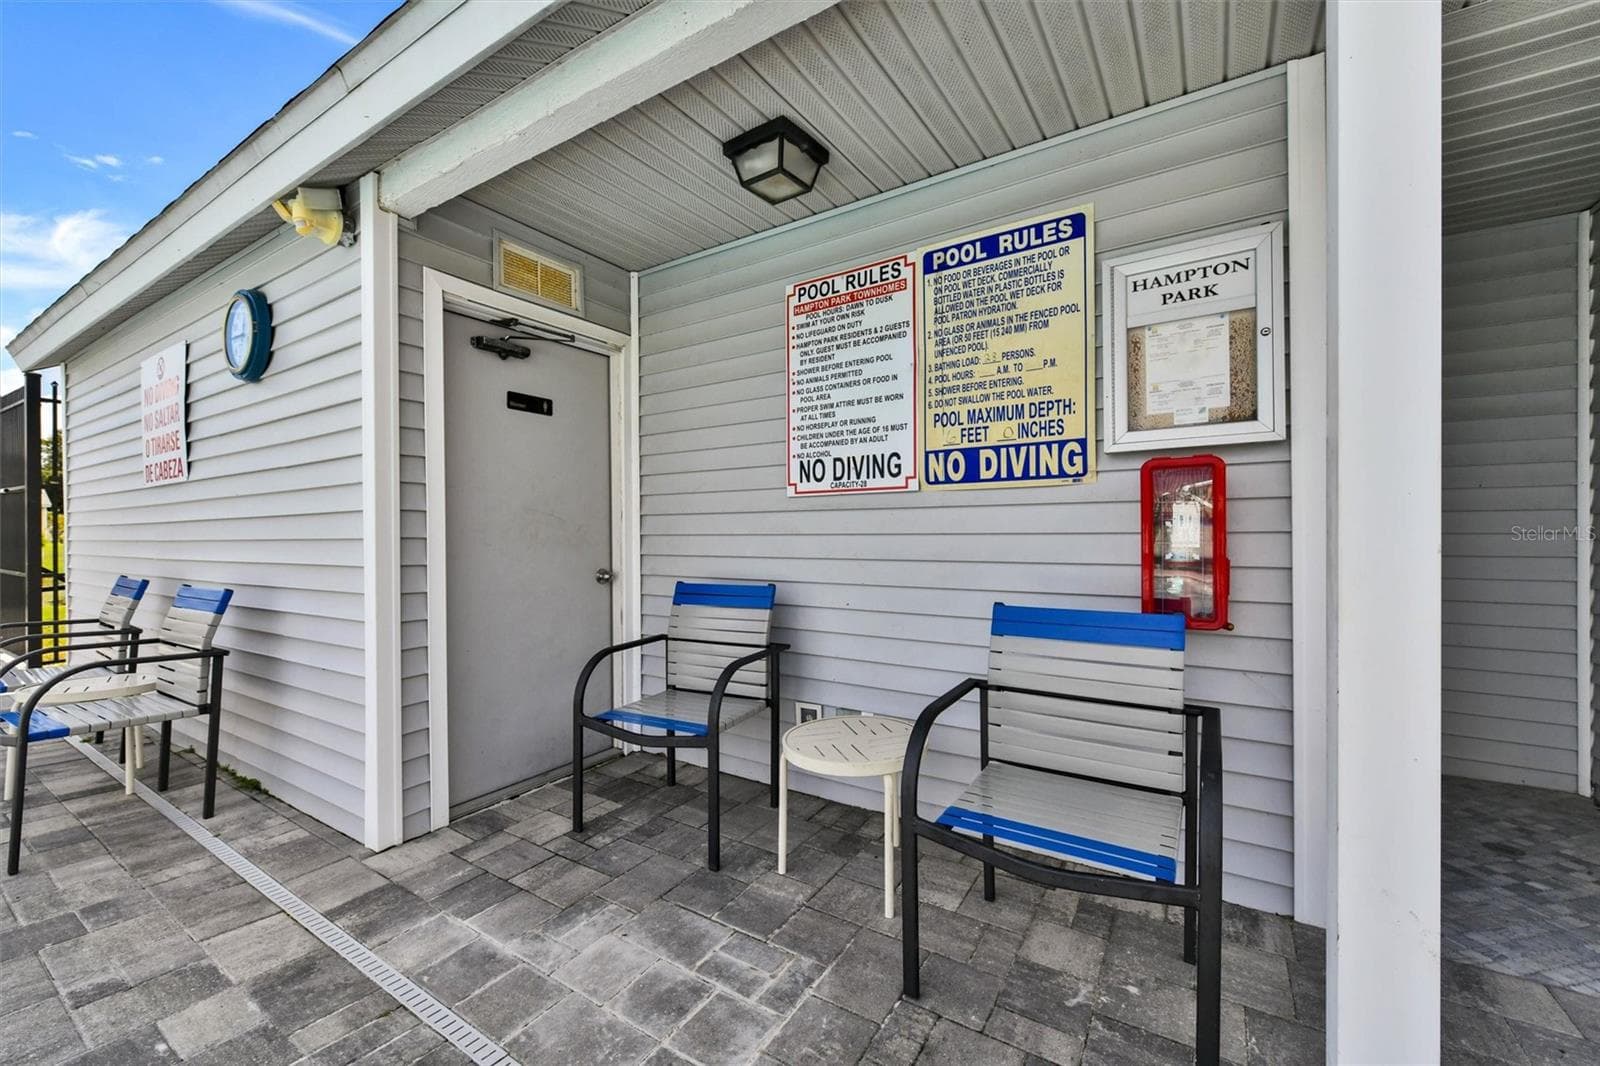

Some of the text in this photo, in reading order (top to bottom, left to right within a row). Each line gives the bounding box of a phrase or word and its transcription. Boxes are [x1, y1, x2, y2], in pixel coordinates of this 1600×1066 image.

[933, 219, 1073, 270] POOL RULES
[933, 246, 1070, 286] NO FOOD OR BEVERAGES IN THE POOL OR
[1132, 258, 1251, 292] HAMPTON
[798, 262, 901, 302] POOL RULES
[934, 260, 1053, 295] ON POOL WET COMMERCIALLY
[934, 270, 1064, 306] BOTTLED WATER IN PLASTIC BOTTLES IS
[794, 280, 906, 315] HAMPTON PARK TOWNHOMES
[934, 281, 1062, 315] ALLOWED ON THE POOL WET DECK FOR
[1162, 284, 1218, 305] PARK
[806, 310, 821, 320] POOL
[846, 301, 864, 311] DAWN
[866, 299, 874, 307] TO
[876, 295, 893, 305] DUSK
[934, 309, 977, 325] POOL PATRON
[796, 309, 865, 331] SWIM AT YOUR OWN RISK
[796, 320, 863, 340] NO LIFEGUARD ON DUTY
[934, 303, 1080, 338] NO GLASS OR ANIMALS IN THE FENCED POOL
[796, 320, 910, 350] HAMPTON PARK RESIDENTS GUESTS
[816, 331, 907, 355] GUEST MUST BE ACCOMPANIED
[935, 337, 950, 347] AREA
[973, 330, 989, 341] FEET
[1029, 319, 1049, 332] FROM
[809, 354, 835, 365] RESIDENT
[934, 345, 966, 359] UNFENCED
[797, 354, 893, 376] SHOWER BEFORE ENTERING POOL
[935, 359, 960, 372] BATHING
[935, 373, 950, 384] POOL
[1013, 363, 1023, 374] TO
[806, 374, 829, 384] ANIMALS
[831, 369, 863, 380] PERMITTED
[806, 385, 824, 393] GLASS
[825, 380, 861, 391] CONTAINERS
[873, 375, 890, 384] FOOD
[800, 393, 831, 403] POOL AREA
[935, 385, 961, 397] SHOWER
[962, 381, 987, 393] BEFORE
[935, 399, 943, 409] DO
[944, 397, 957, 408] NOT
[958, 393, 991, 406] SWALLOW
[992, 392, 1005, 402] THE
[1006, 389, 1025, 400] POOL
[797, 404, 818, 413] PROPER
[820, 402, 834, 410] SWIM
[835, 400, 855, 408] ATTIRE
[857, 397, 873, 405] MUST
[884, 393, 904, 402] WORN
[934, 398, 1076, 428] POOL MAXIMUM DEPTH:
[806, 421, 838, 430] HORSEPLAY
[849, 416, 876, 425] RUNNING
[819, 411, 836, 419] TIMES
[797, 432, 824, 441] CHILDREN
[825, 430, 844, 439] UNDER
[858, 427, 870, 435] AGE
[872, 426, 880, 434] OF
[891, 423, 908, 432] MUST
[961, 426, 989, 443] FEET
[1018, 419, 1064, 438] INCHES
[809, 438, 849, 448] ACCOMPANIED
[869, 434, 888, 443] ADULT
[145, 457, 184, 483] DE CABEZA
[800, 452, 901, 483] NO DIVING
[928, 441, 1083, 482] NO DIVING
